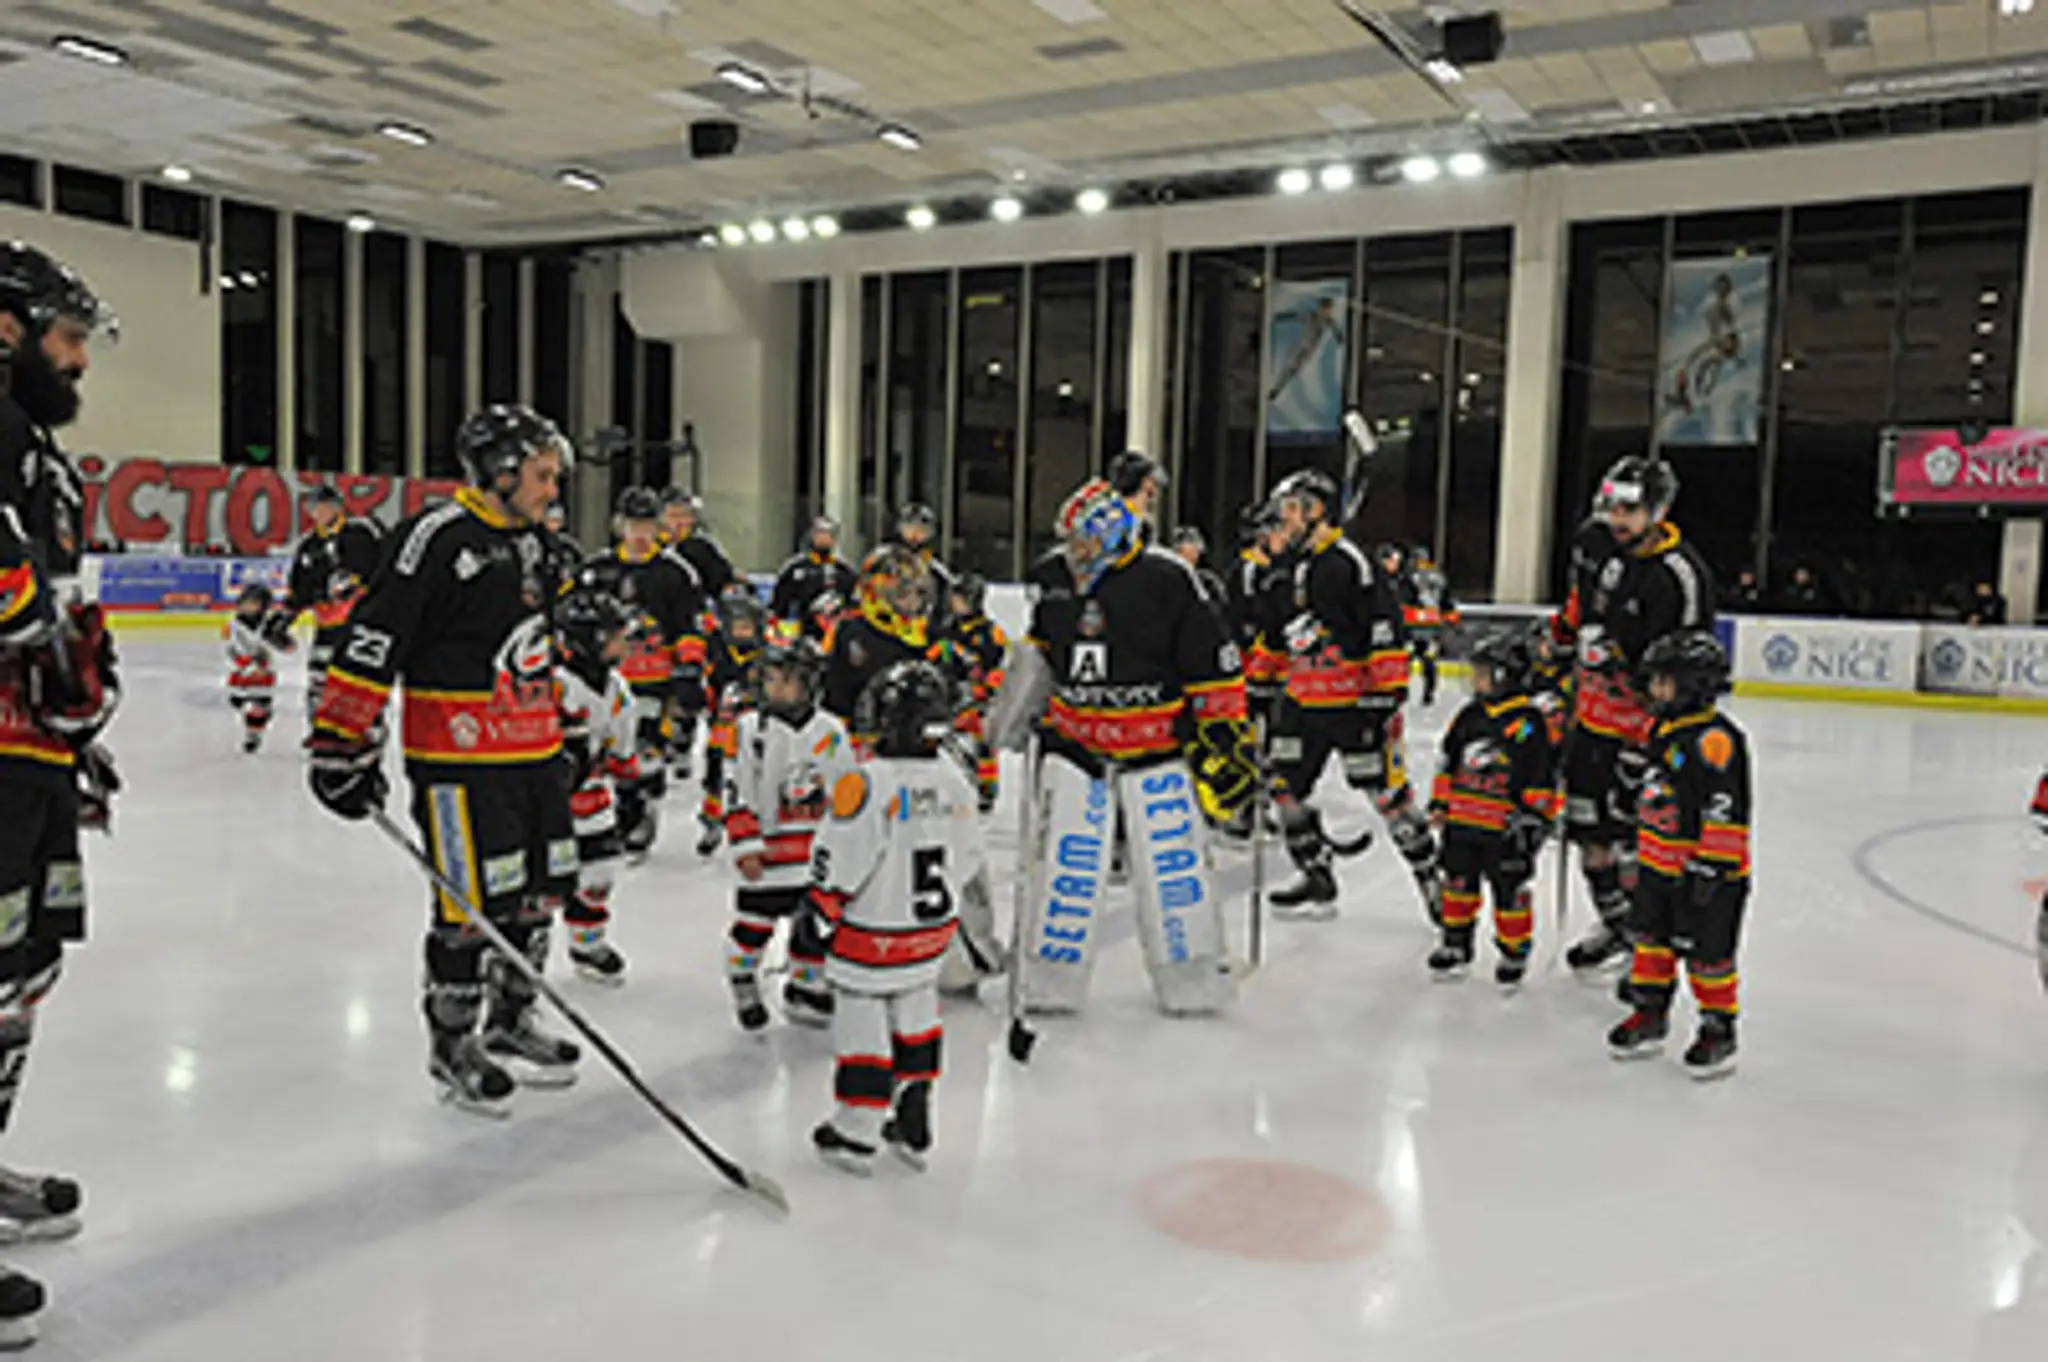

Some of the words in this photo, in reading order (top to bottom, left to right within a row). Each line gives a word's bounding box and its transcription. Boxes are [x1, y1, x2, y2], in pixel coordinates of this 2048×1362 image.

[347, 624, 393, 667] 23
[1069, 643, 1107, 682] A
[1705, 793, 1732, 821] 2
[912, 847, 953, 921] 5
